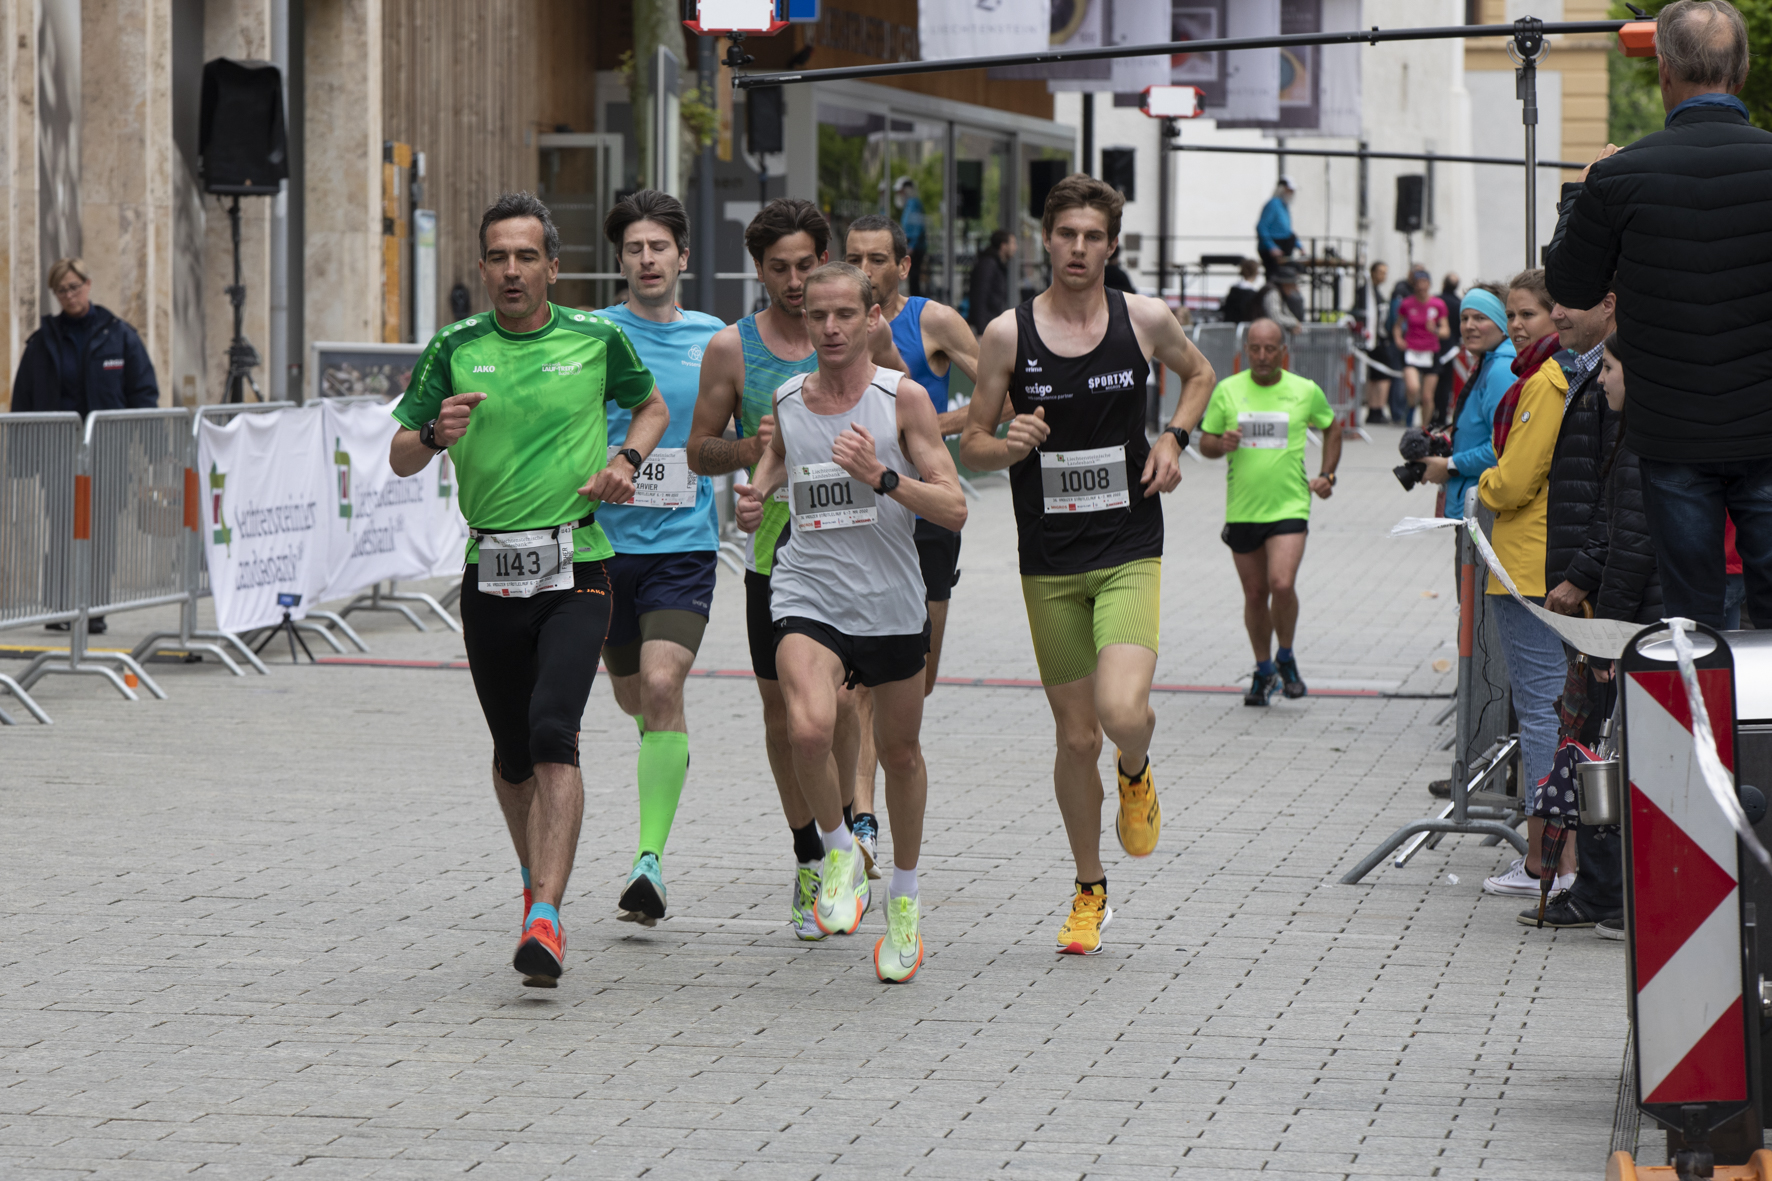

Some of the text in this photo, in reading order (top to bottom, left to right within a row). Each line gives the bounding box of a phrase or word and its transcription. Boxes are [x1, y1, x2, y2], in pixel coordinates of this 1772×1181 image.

[1025, 383, 1053, 397] exigo
[1252, 422, 1275, 437] 1112
[1061, 467, 1110, 493] 1008
[808, 481, 853, 509] 1001
[496, 551, 541, 577] 1143
